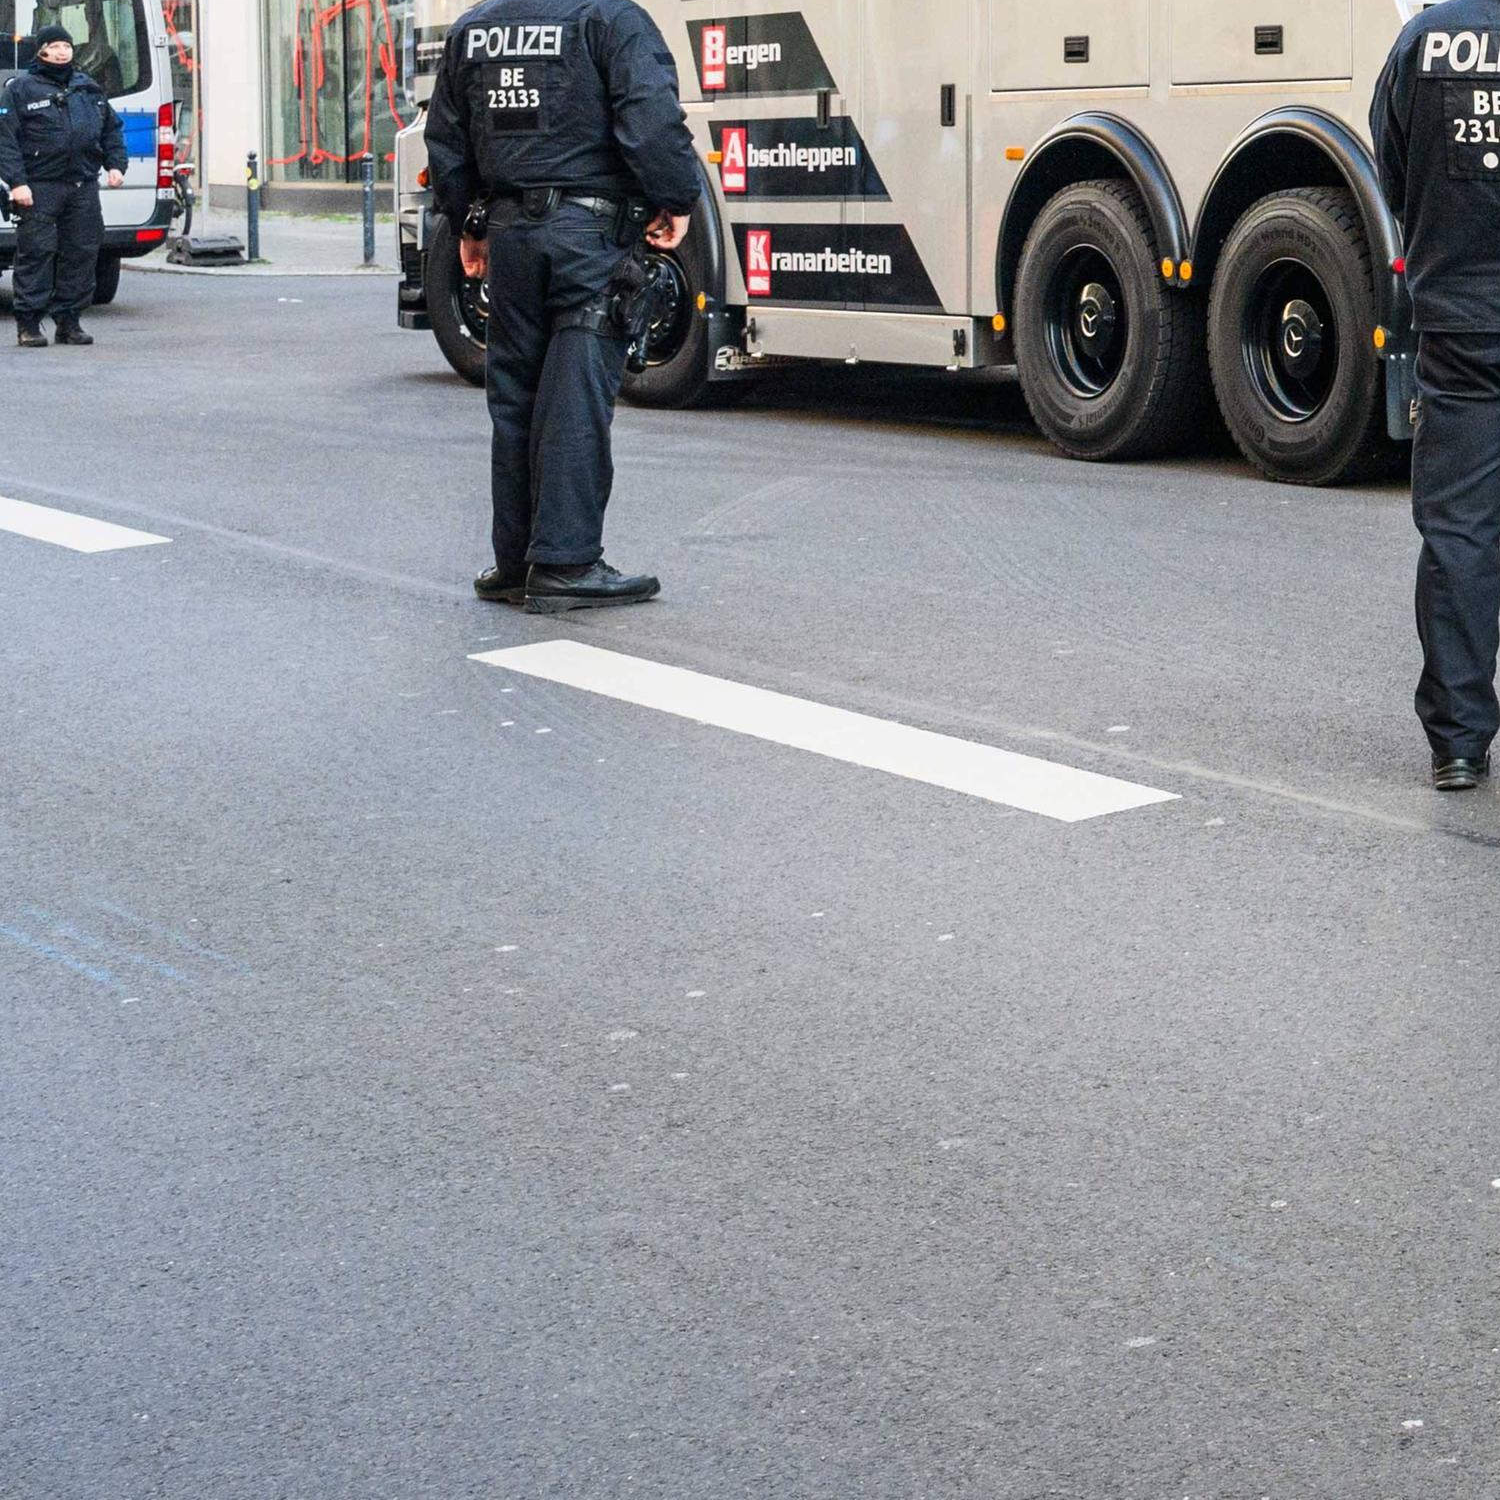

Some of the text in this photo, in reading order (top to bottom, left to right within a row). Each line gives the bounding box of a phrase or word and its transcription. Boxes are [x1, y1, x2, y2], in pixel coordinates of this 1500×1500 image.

[466, 25, 563, 59] POLIZEI
[703, 29, 782, 70] Bergen
[500, 67, 525, 88] BE
[487, 88, 541, 109] 23133
[723, 131, 857, 173] Abschleppen
[749, 234, 893, 275] Kranarbeiten
